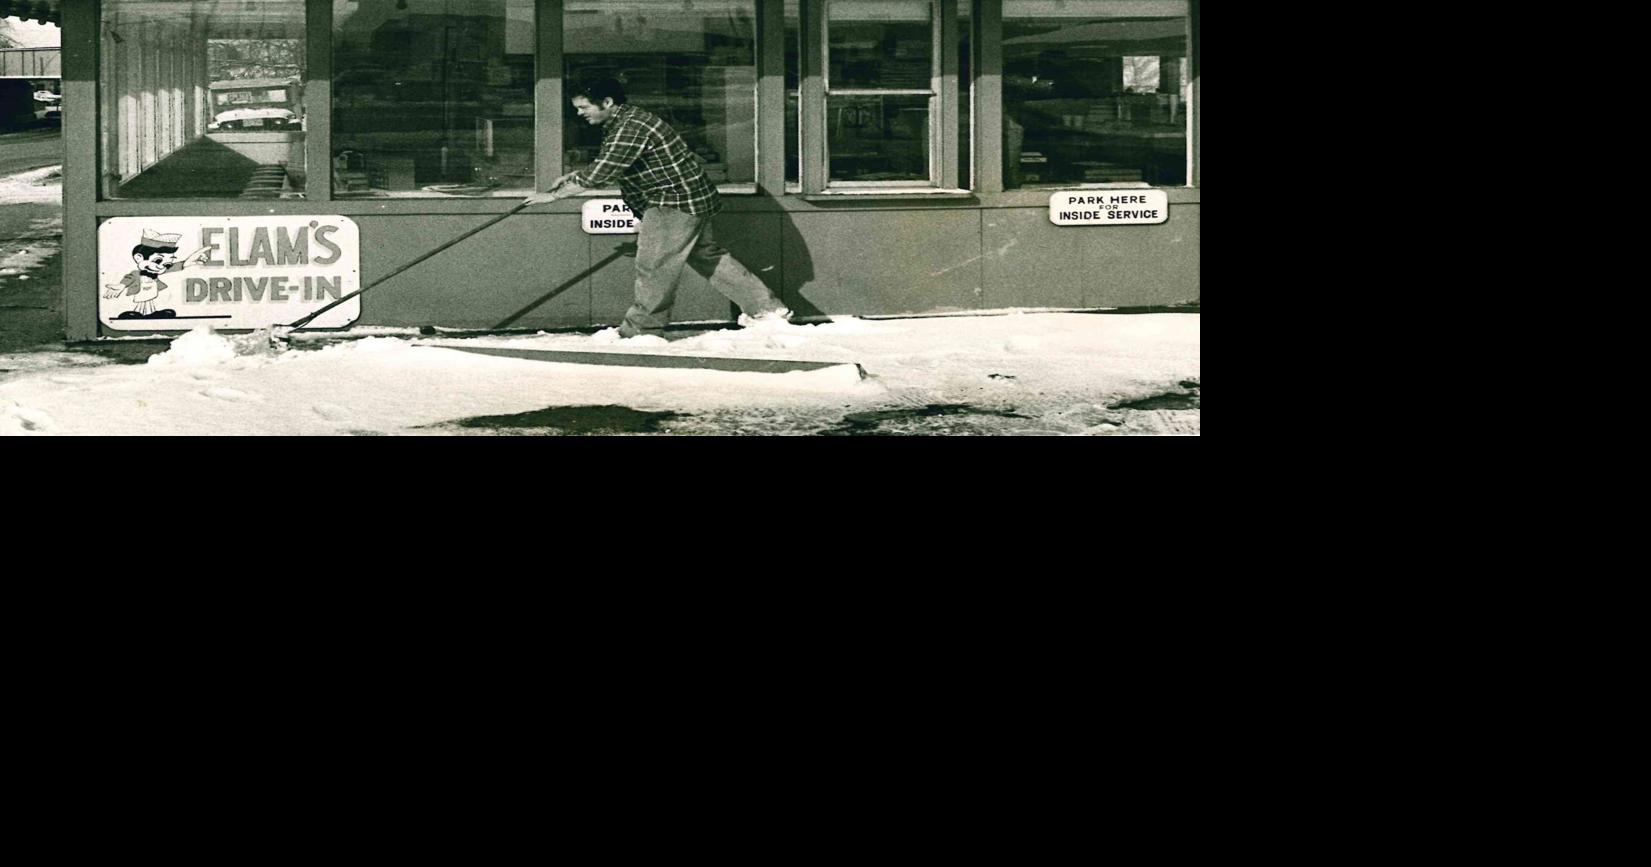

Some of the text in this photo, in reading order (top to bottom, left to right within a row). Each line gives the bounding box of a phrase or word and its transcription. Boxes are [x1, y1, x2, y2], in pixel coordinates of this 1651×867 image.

[1068, 195, 1147, 204] PARK HERE
[602, 204, 631, 212] PAR
[1059, 210, 1159, 220] INSIDE SERVICE
[590, 219, 634, 229] INSIDE
[201, 220, 342, 267] ELAM'S
[185, 276, 342, 303] DRIVE-IN
